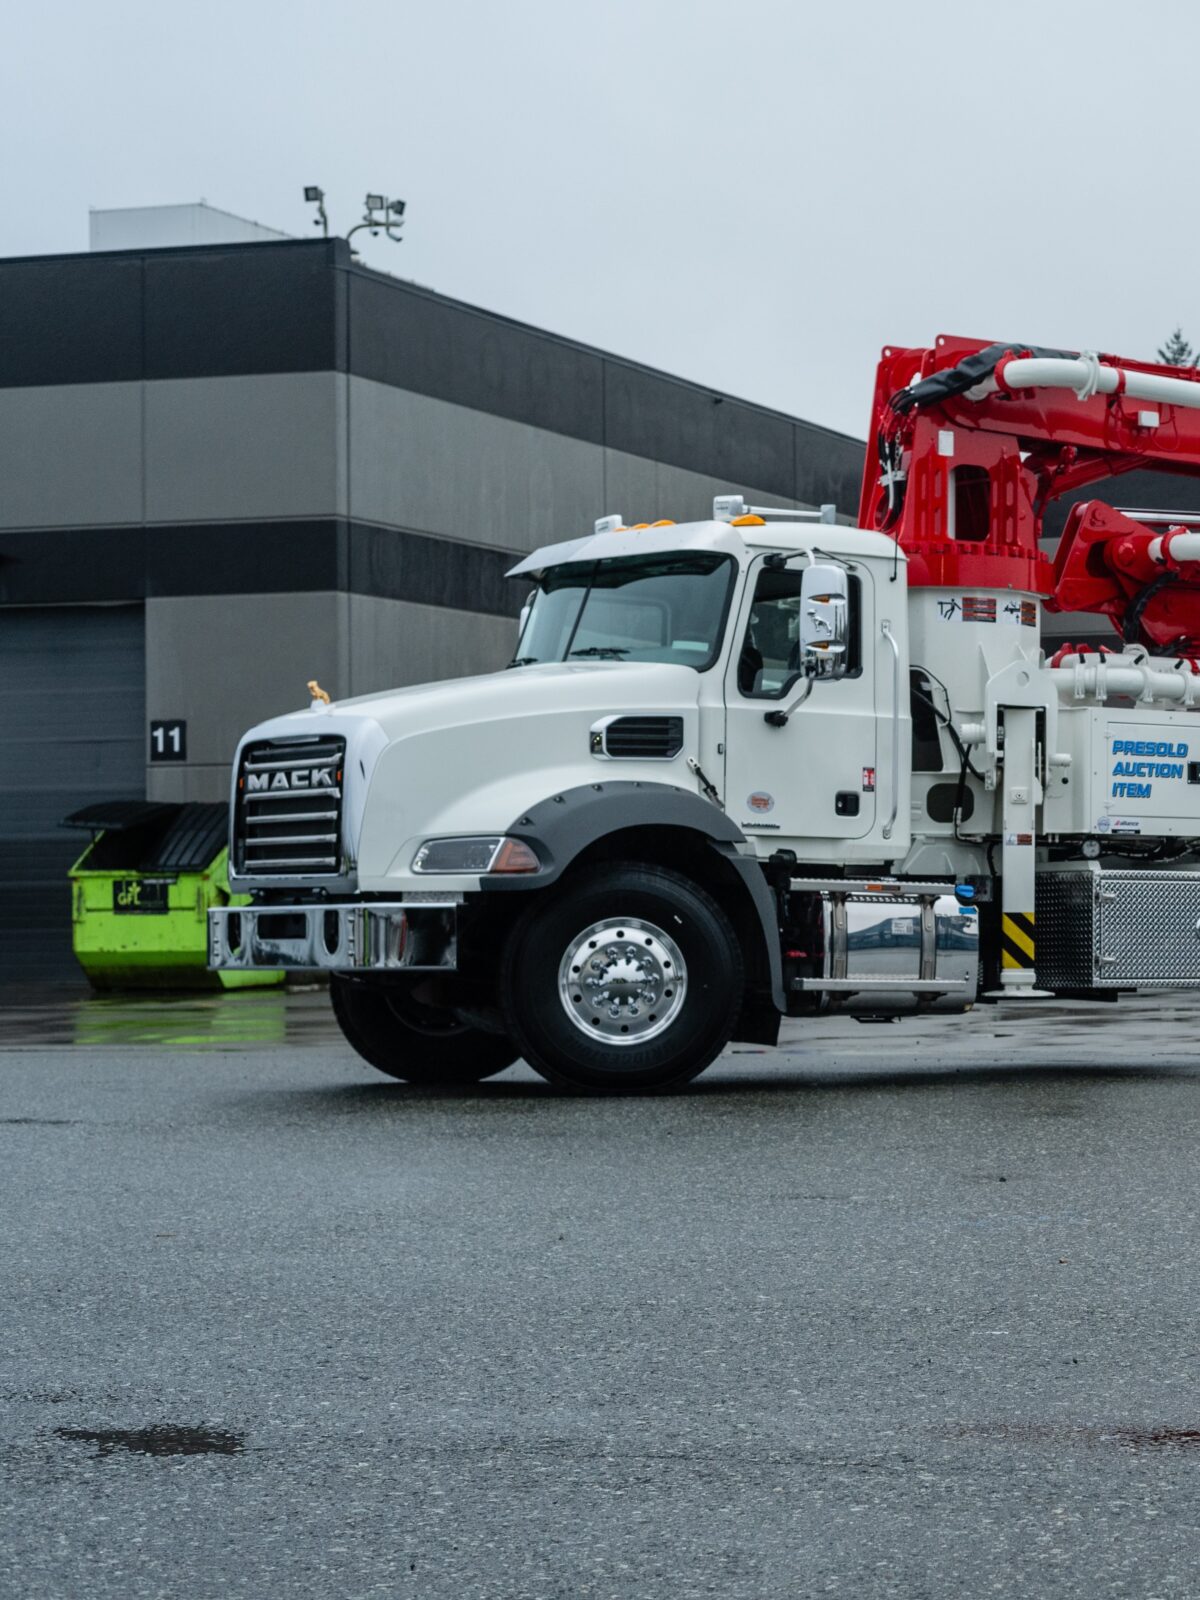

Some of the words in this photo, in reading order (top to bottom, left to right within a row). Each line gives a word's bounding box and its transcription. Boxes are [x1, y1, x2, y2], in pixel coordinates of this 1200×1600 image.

[152, 726, 180, 753] 11
[1112, 740, 1189, 758] PRESOLD
[247, 767, 333, 790] MACK
[1112, 761, 1184, 779] AUCTION
[1112, 782, 1152, 798] ITEM
